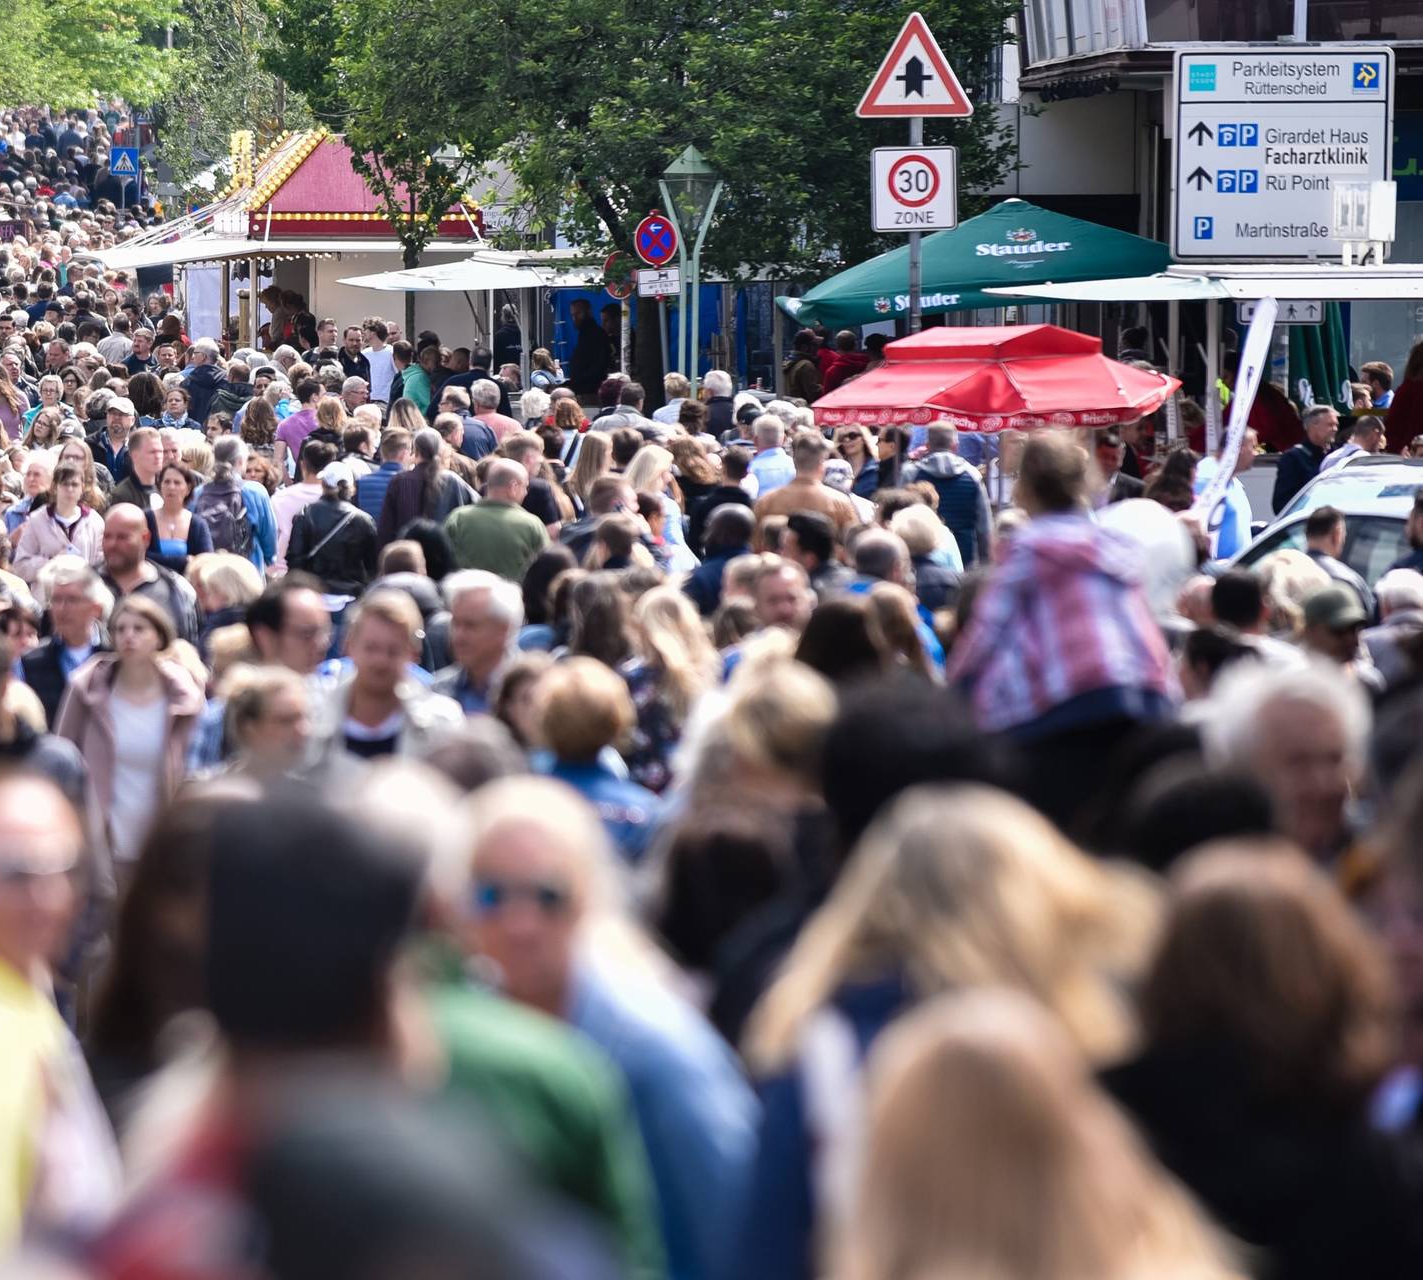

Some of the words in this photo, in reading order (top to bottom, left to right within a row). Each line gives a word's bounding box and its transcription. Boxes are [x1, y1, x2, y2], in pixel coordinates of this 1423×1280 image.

[1232, 61, 1340, 81] Parkleitsystem
[1245, 81, 1327, 95] Rüttenscheid
[1265, 128, 1326, 144] Girardet
[1330, 128, 1369, 144] Haus
[1265, 147, 1369, 165] Facharztklinik
[898, 169, 929, 193] 30
[1266, 175, 1287, 191] Rü
[1292, 174, 1331, 191] Point
[894, 211, 935, 225] ZONE
[1235, 222, 1329, 238] Martinstraße
[975, 240, 1073, 256] Stauder
[894, 292, 961, 311] Studer
